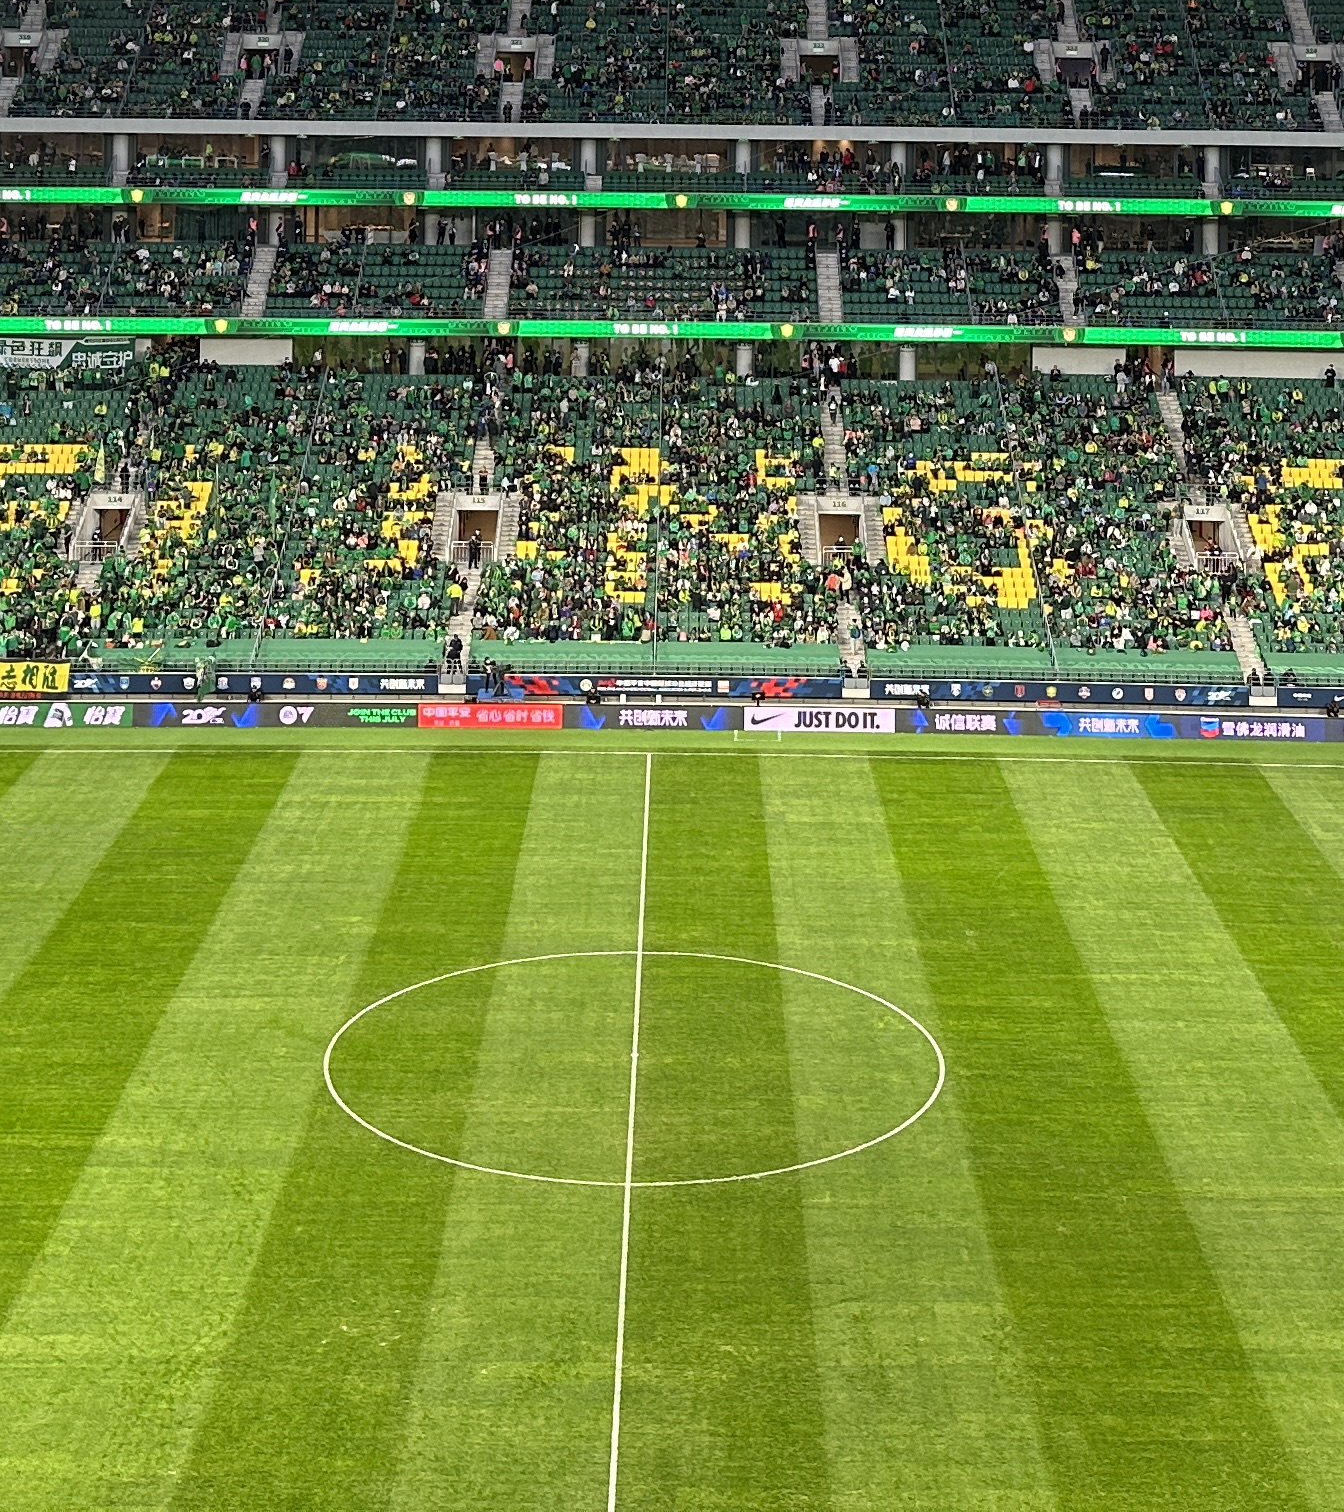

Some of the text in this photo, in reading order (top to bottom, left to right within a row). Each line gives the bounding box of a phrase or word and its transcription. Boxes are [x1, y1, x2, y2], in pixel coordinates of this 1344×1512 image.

[2, 190, 23, 200] NO.
[25, 190, 31, 200] 1
[514, 194, 531, 205] TO
[549, 194, 569, 205] NO.
[571, 194, 577, 205] 1
[1058, 200, 1073, 211] TO
[1092, 201, 1113, 211] NO.
[1115, 201, 1121, 211] 1
[44, 320, 61, 330] TO
[82, 320, 103, 330] NO.
[106, 320, 111, 330] 1
[613, 324, 630, 335] TO
[649, 324, 670, 335] NO.
[672, 324, 678, 335] 1
[1180, 331, 1196, 342] TO
[1217, 332, 1238, 342] NO.
[1240, 332, 1246, 342] 1
[347, 708, 371, 716] JOIN
[391, 708, 416, 716] CLUB
[794, 711, 880, 729] JUST DO IT.
[934, 714, 997, 731] 诚信联赛
[1221, 721, 1306, 738] 雪佛龙润滑油
